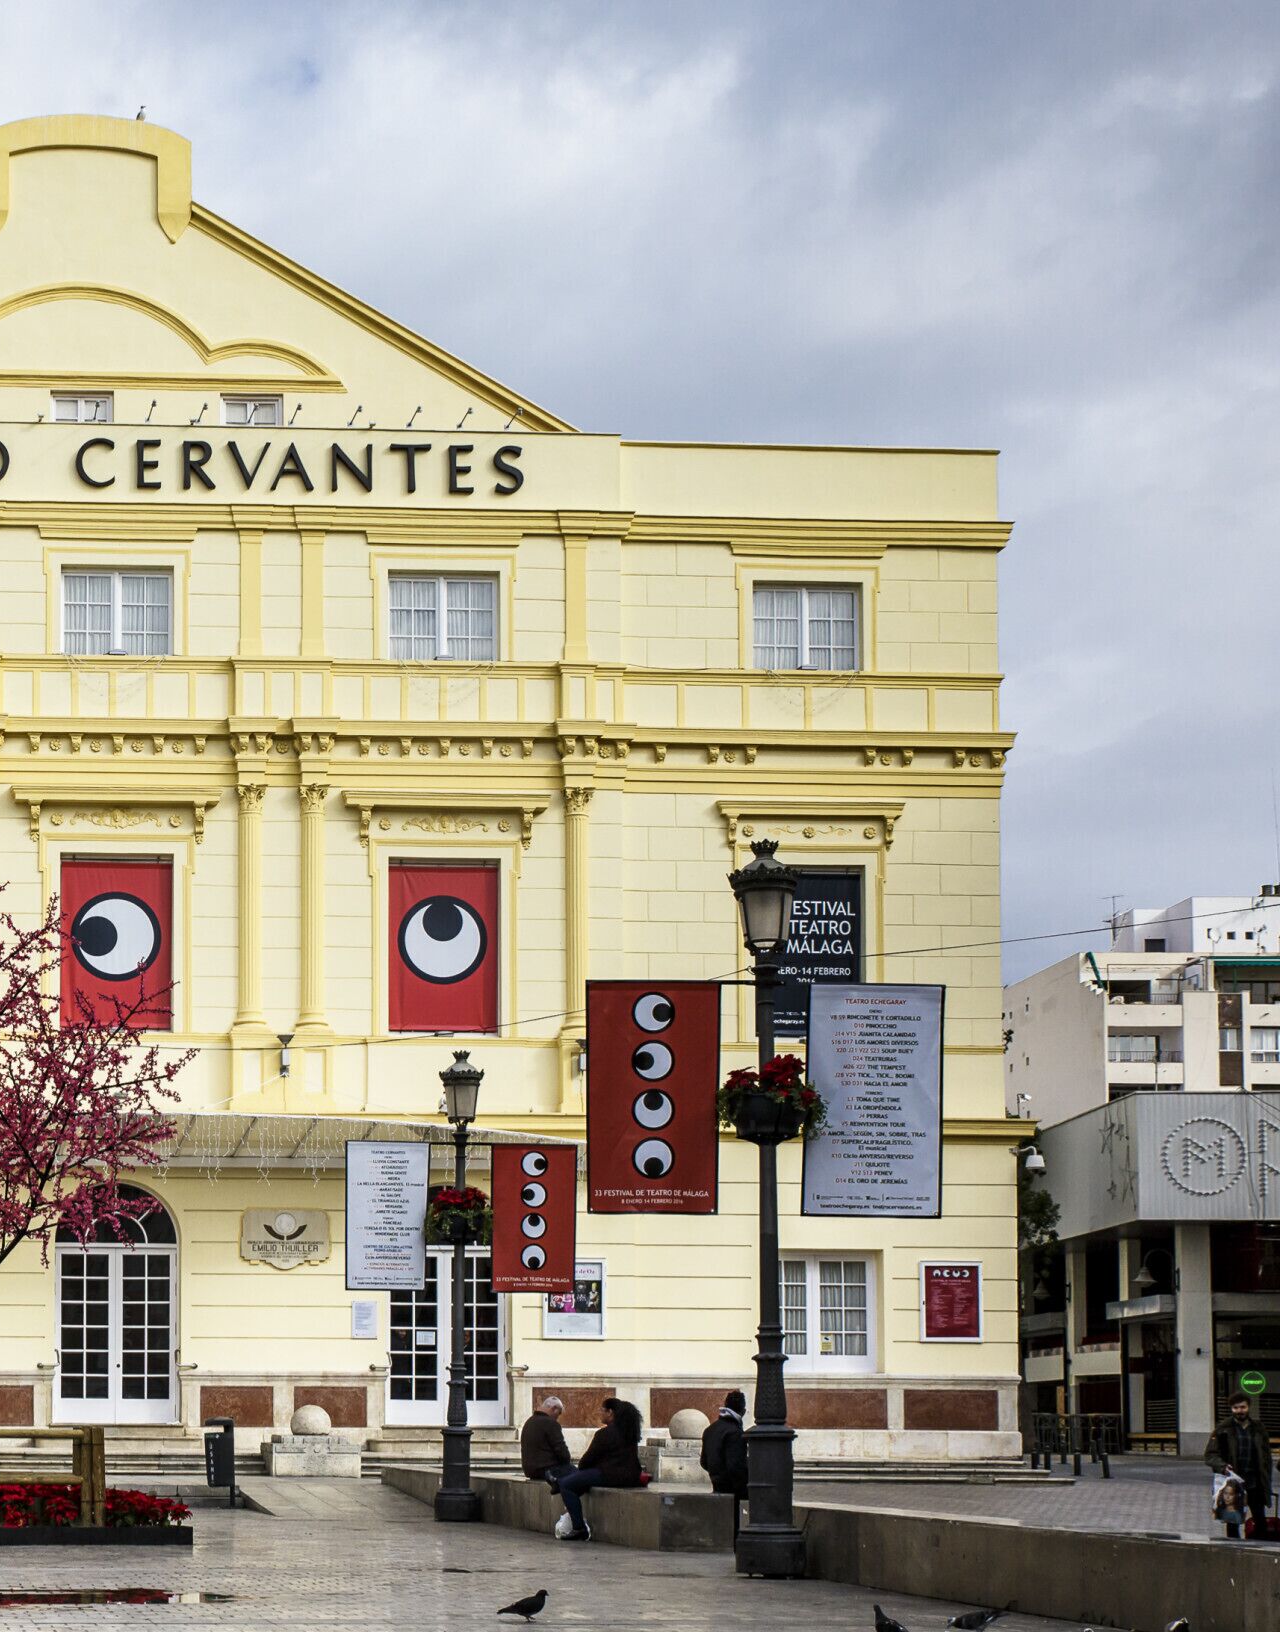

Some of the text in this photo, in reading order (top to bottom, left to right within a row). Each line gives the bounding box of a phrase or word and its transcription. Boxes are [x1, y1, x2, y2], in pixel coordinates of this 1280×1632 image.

[75, 437, 524, 495] CERVANTES
[792, 901, 856, 916] ESTIVAL
[789, 920, 851, 935] TEATRO
[786, 936, 854, 954] MÁLAGA
[813, 967, 851, 976] FEBRERO
[594, 1189, 709, 1197] 33 FESTIVAL DE TEATRO DE MÁLAGA
